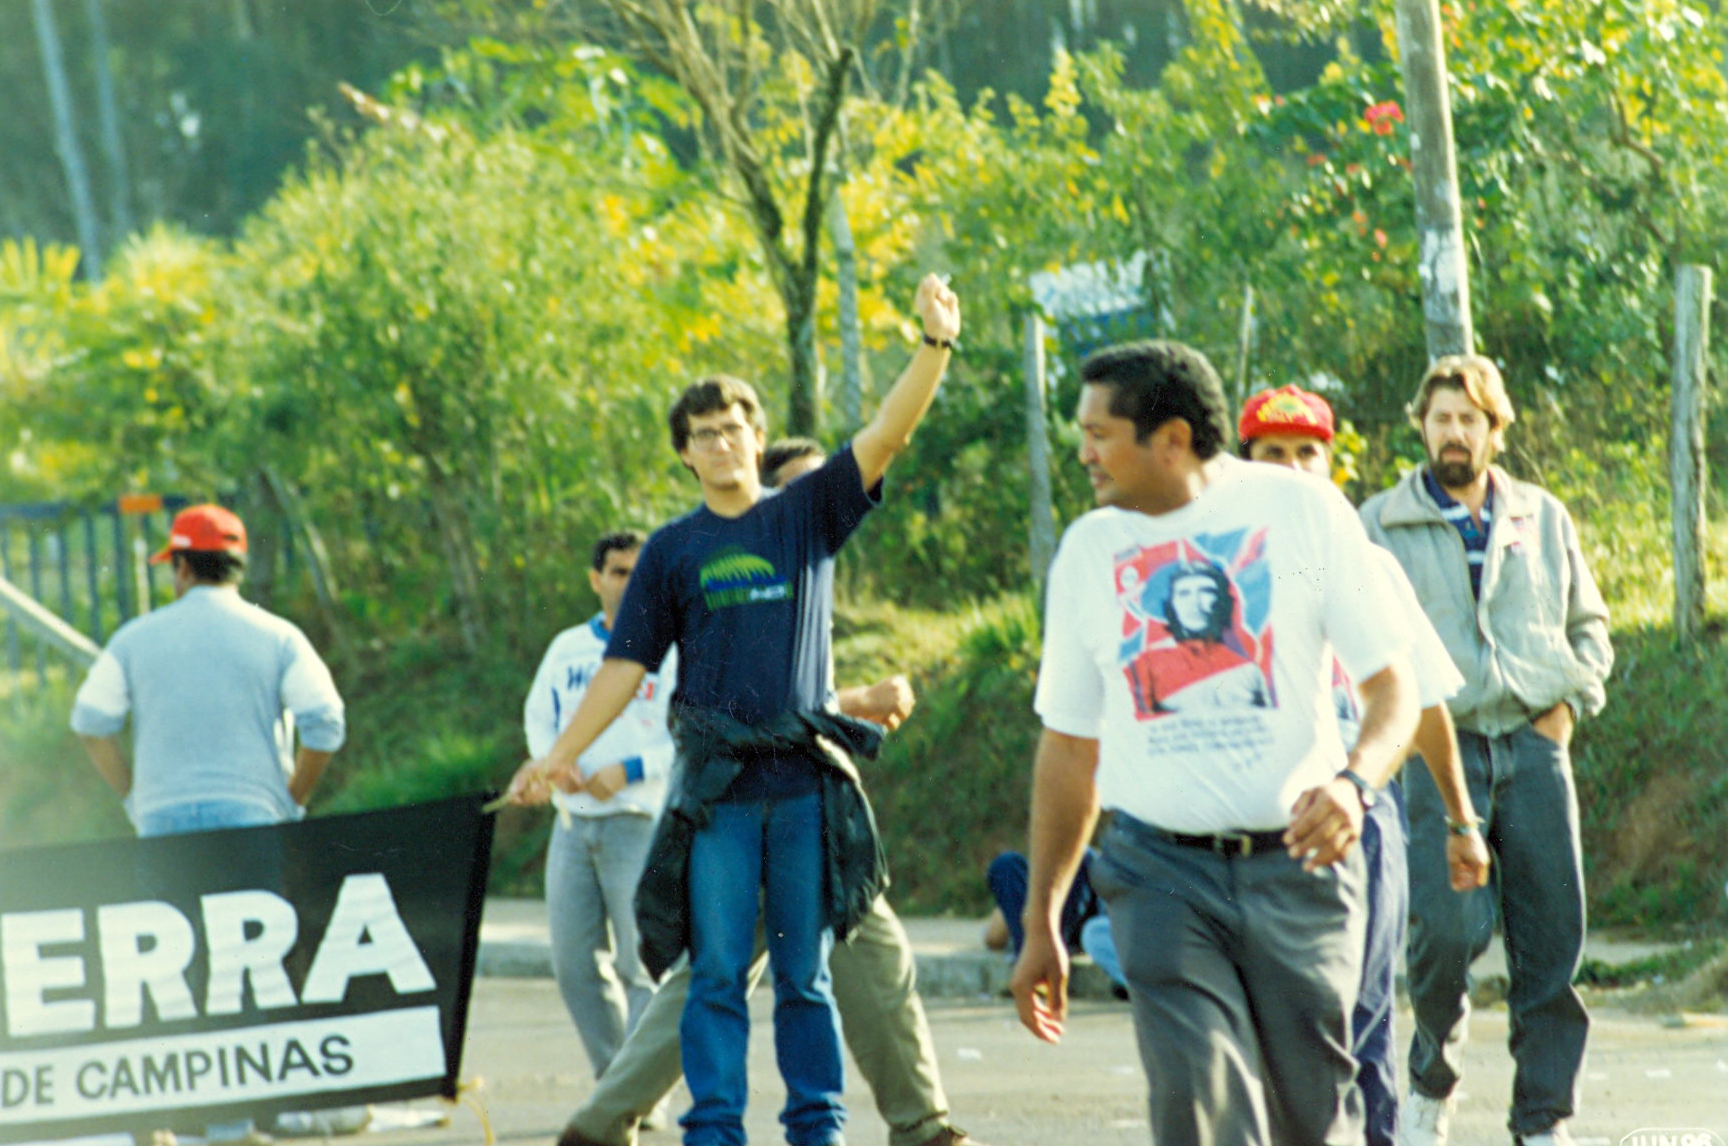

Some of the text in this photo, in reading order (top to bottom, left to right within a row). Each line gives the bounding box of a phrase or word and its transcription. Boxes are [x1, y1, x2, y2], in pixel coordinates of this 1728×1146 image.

[1, 873, 437, 1038] ERRA
[1, 1035, 354, 1108] DE CAMPINAS
